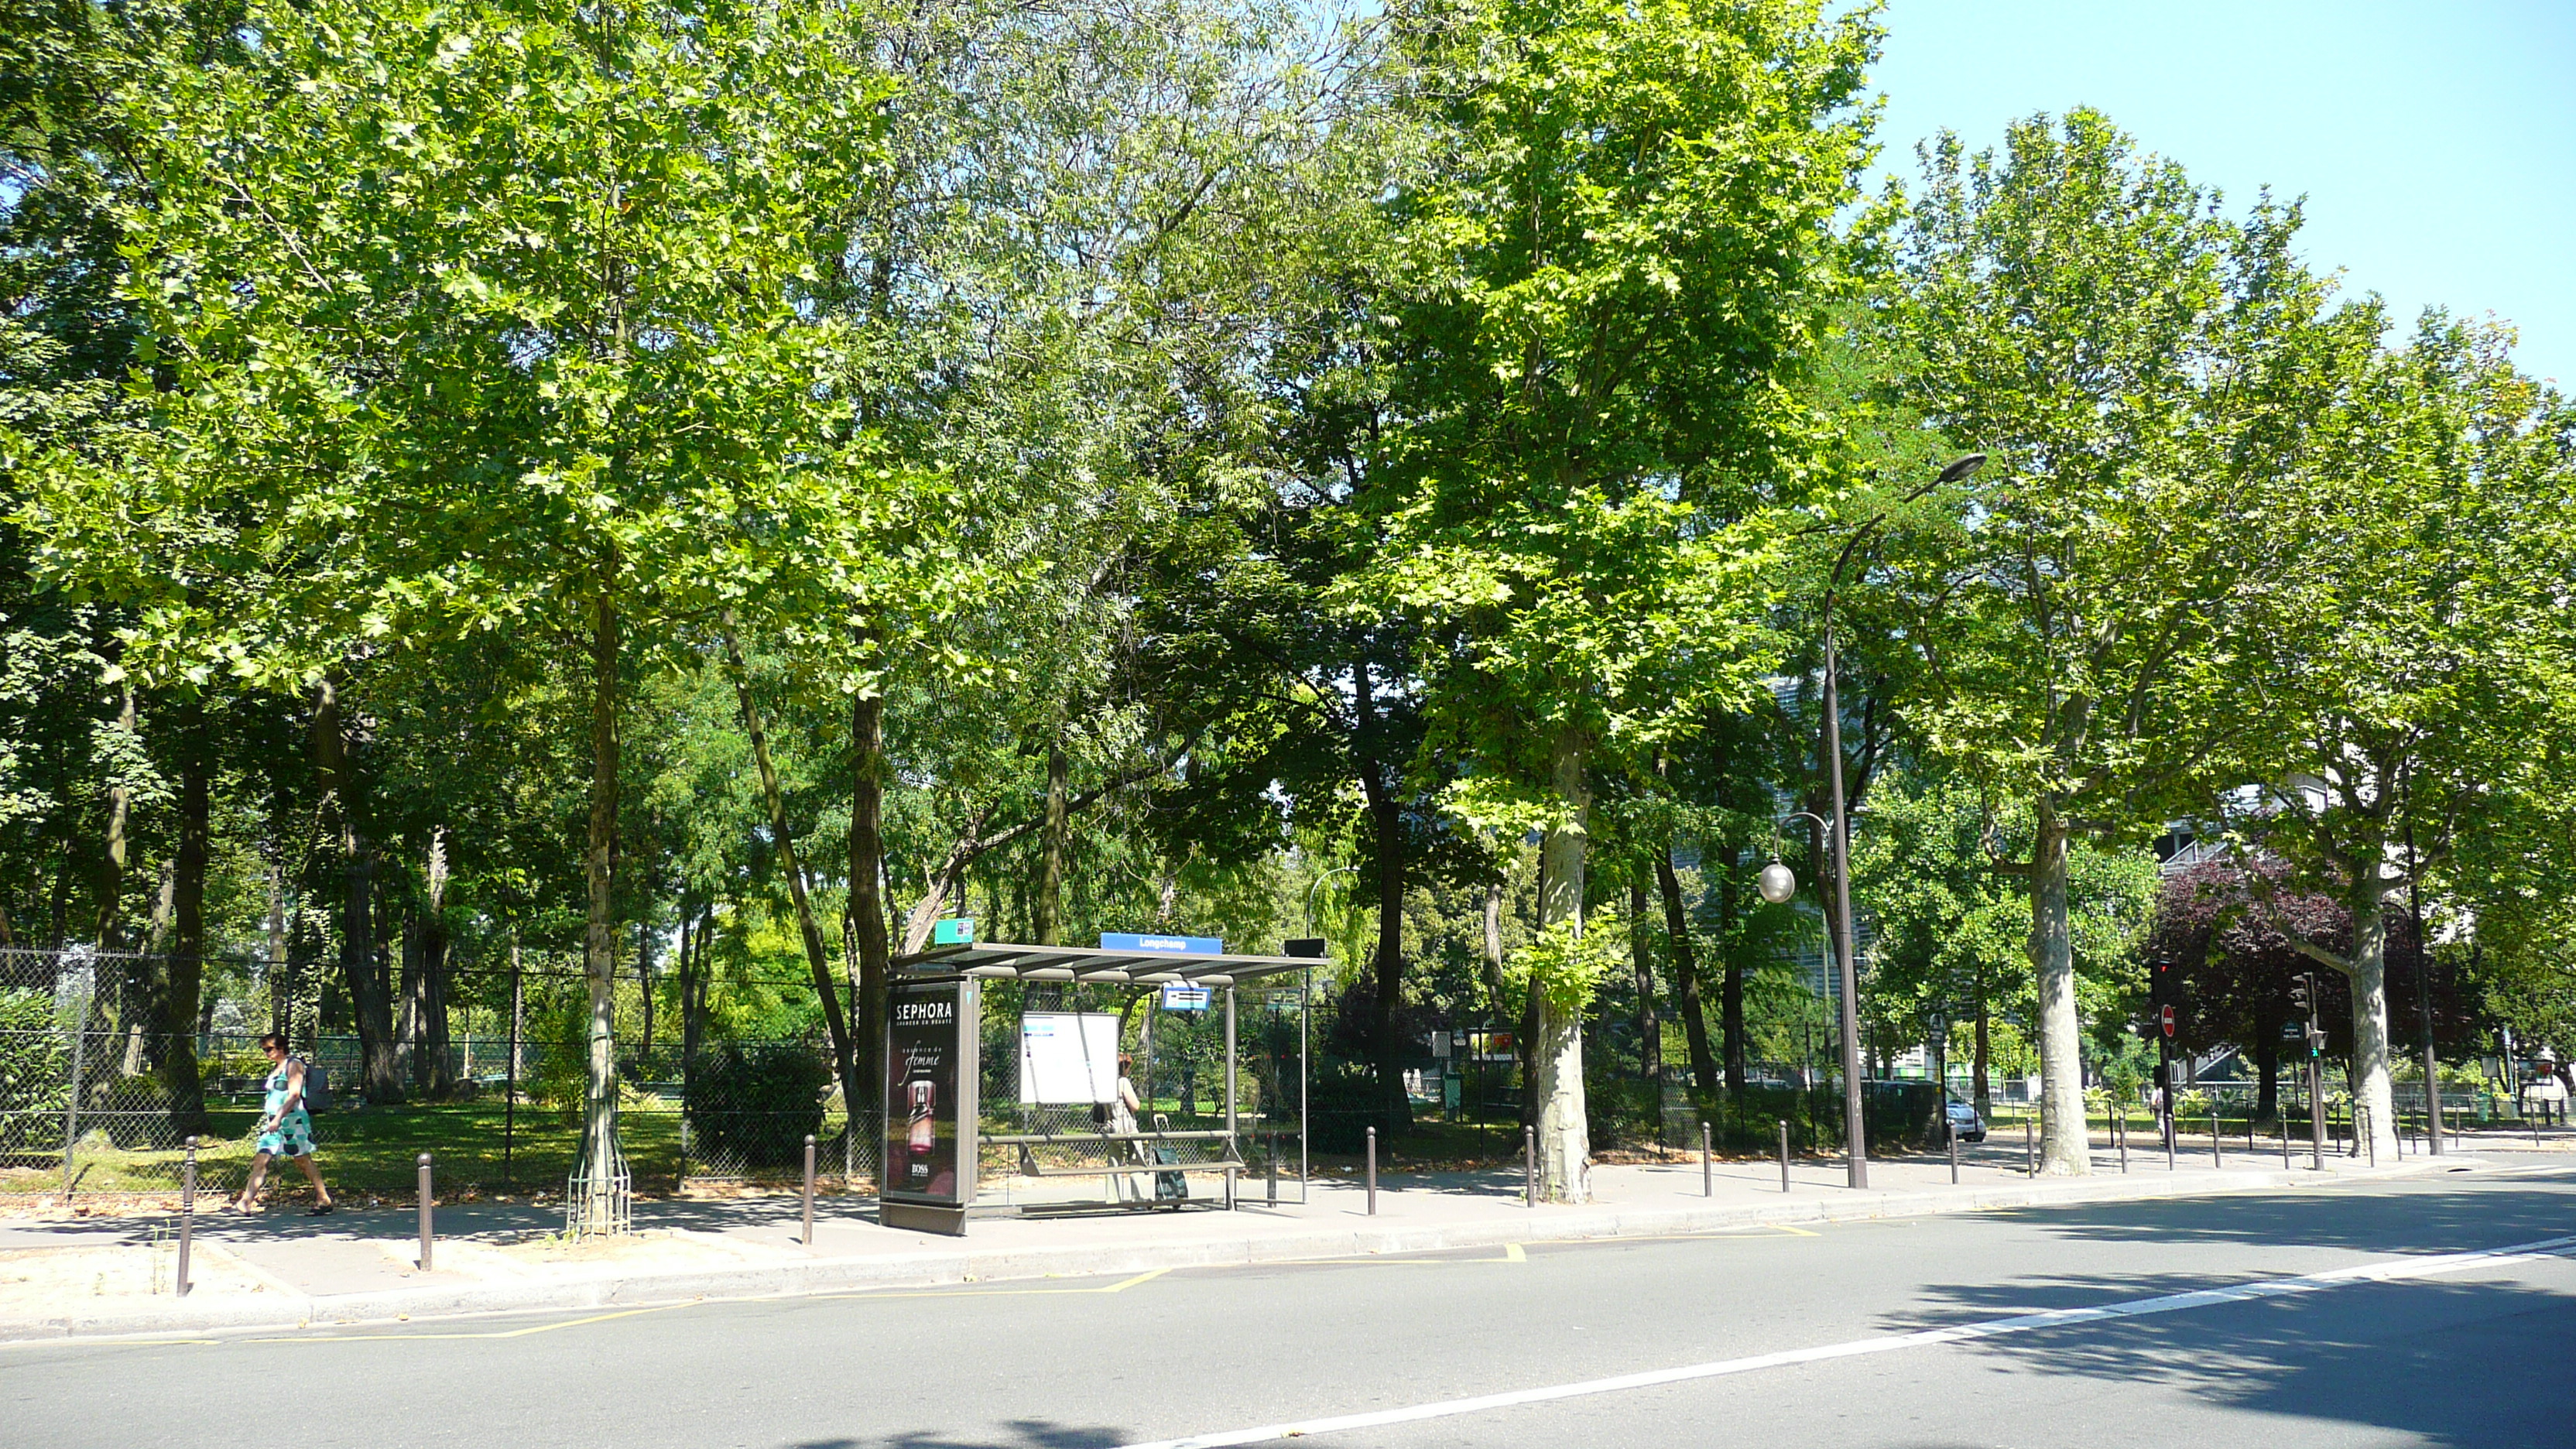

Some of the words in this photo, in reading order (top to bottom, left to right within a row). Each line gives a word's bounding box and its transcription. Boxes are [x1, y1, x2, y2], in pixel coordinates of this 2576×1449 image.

[1139, 937, 1187, 951] Longchamp
[896, 1002, 952, 1020] SEPHORA
[912, 1163, 928, 1173] BOSS
